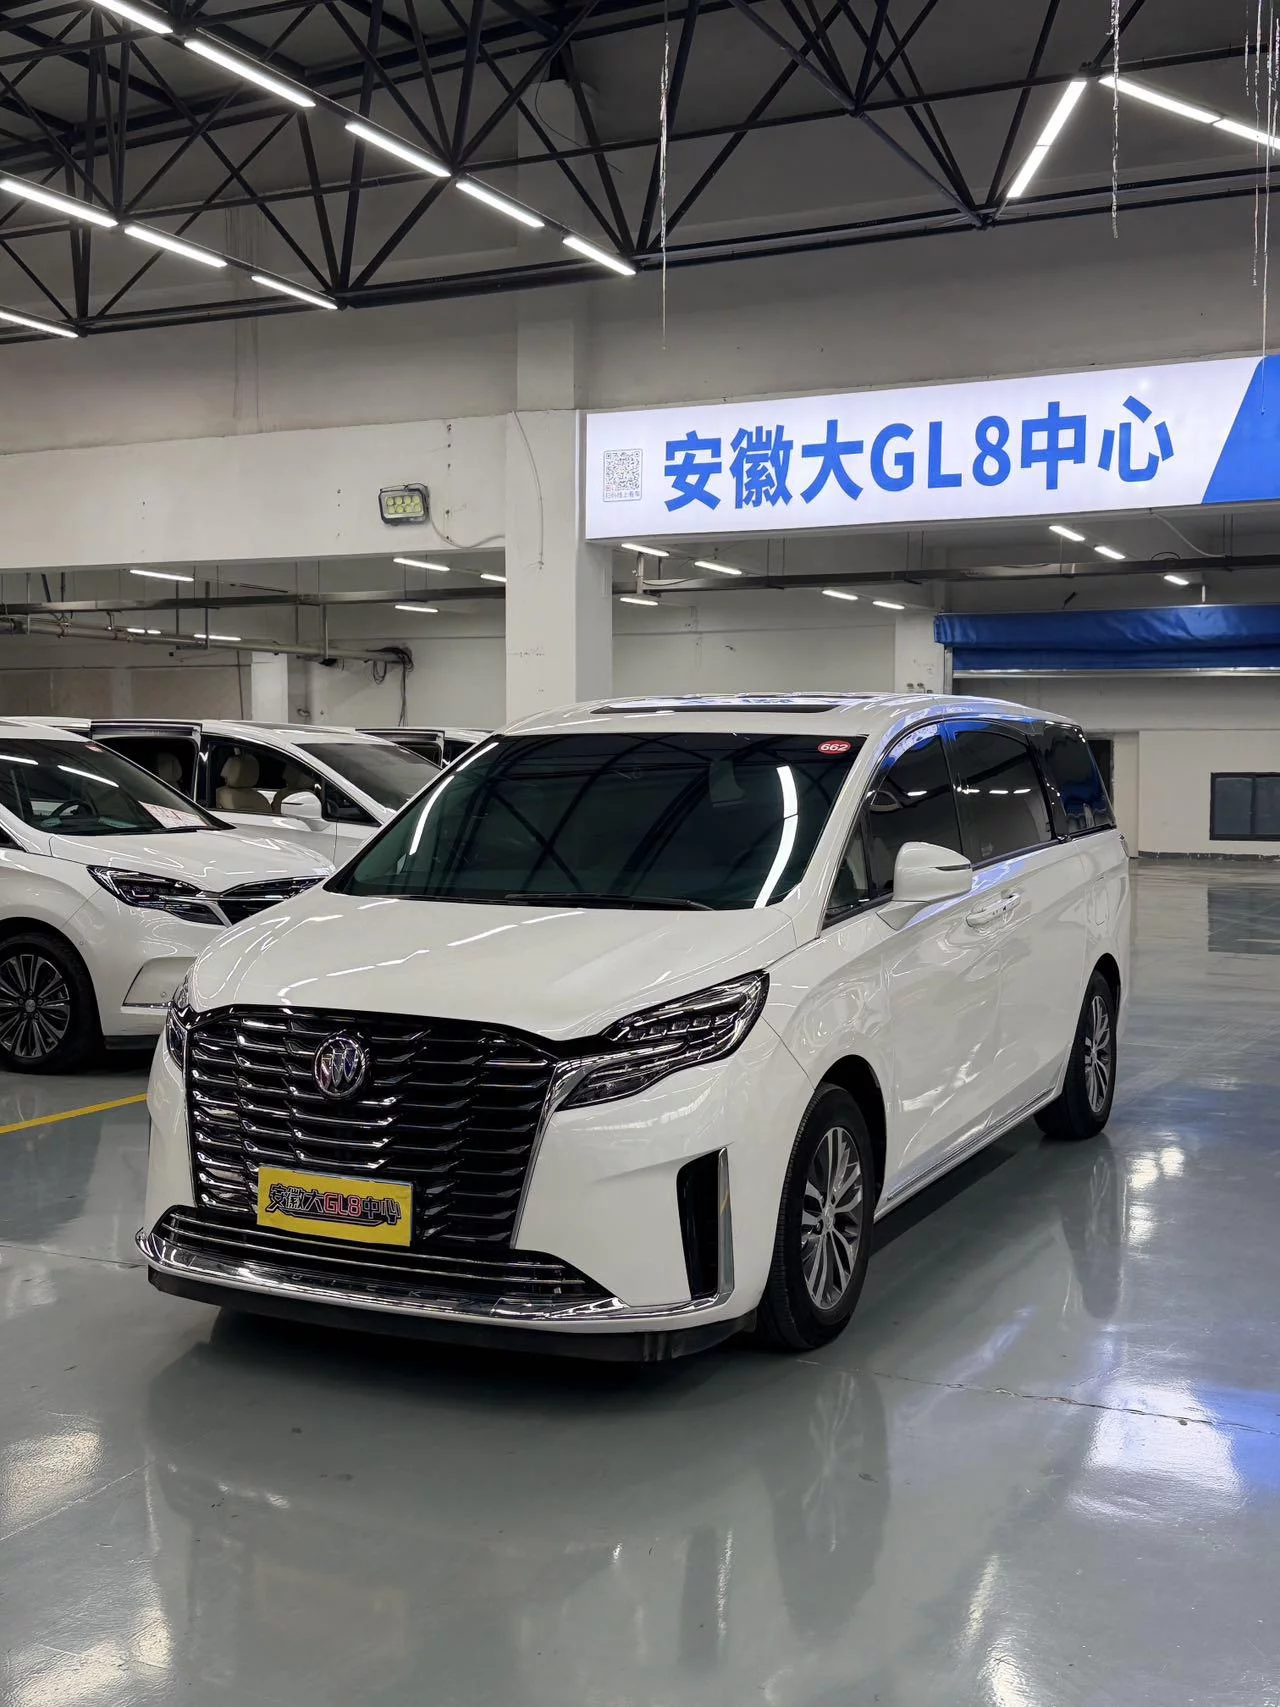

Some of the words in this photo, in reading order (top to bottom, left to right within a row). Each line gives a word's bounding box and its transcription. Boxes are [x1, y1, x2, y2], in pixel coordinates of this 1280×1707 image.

[665, 396, 1174, 511] 安徽大GL8中心
[820, 743, 849, 752] 662
[266, 1183, 402, 1226] 安徽大GL8中心
